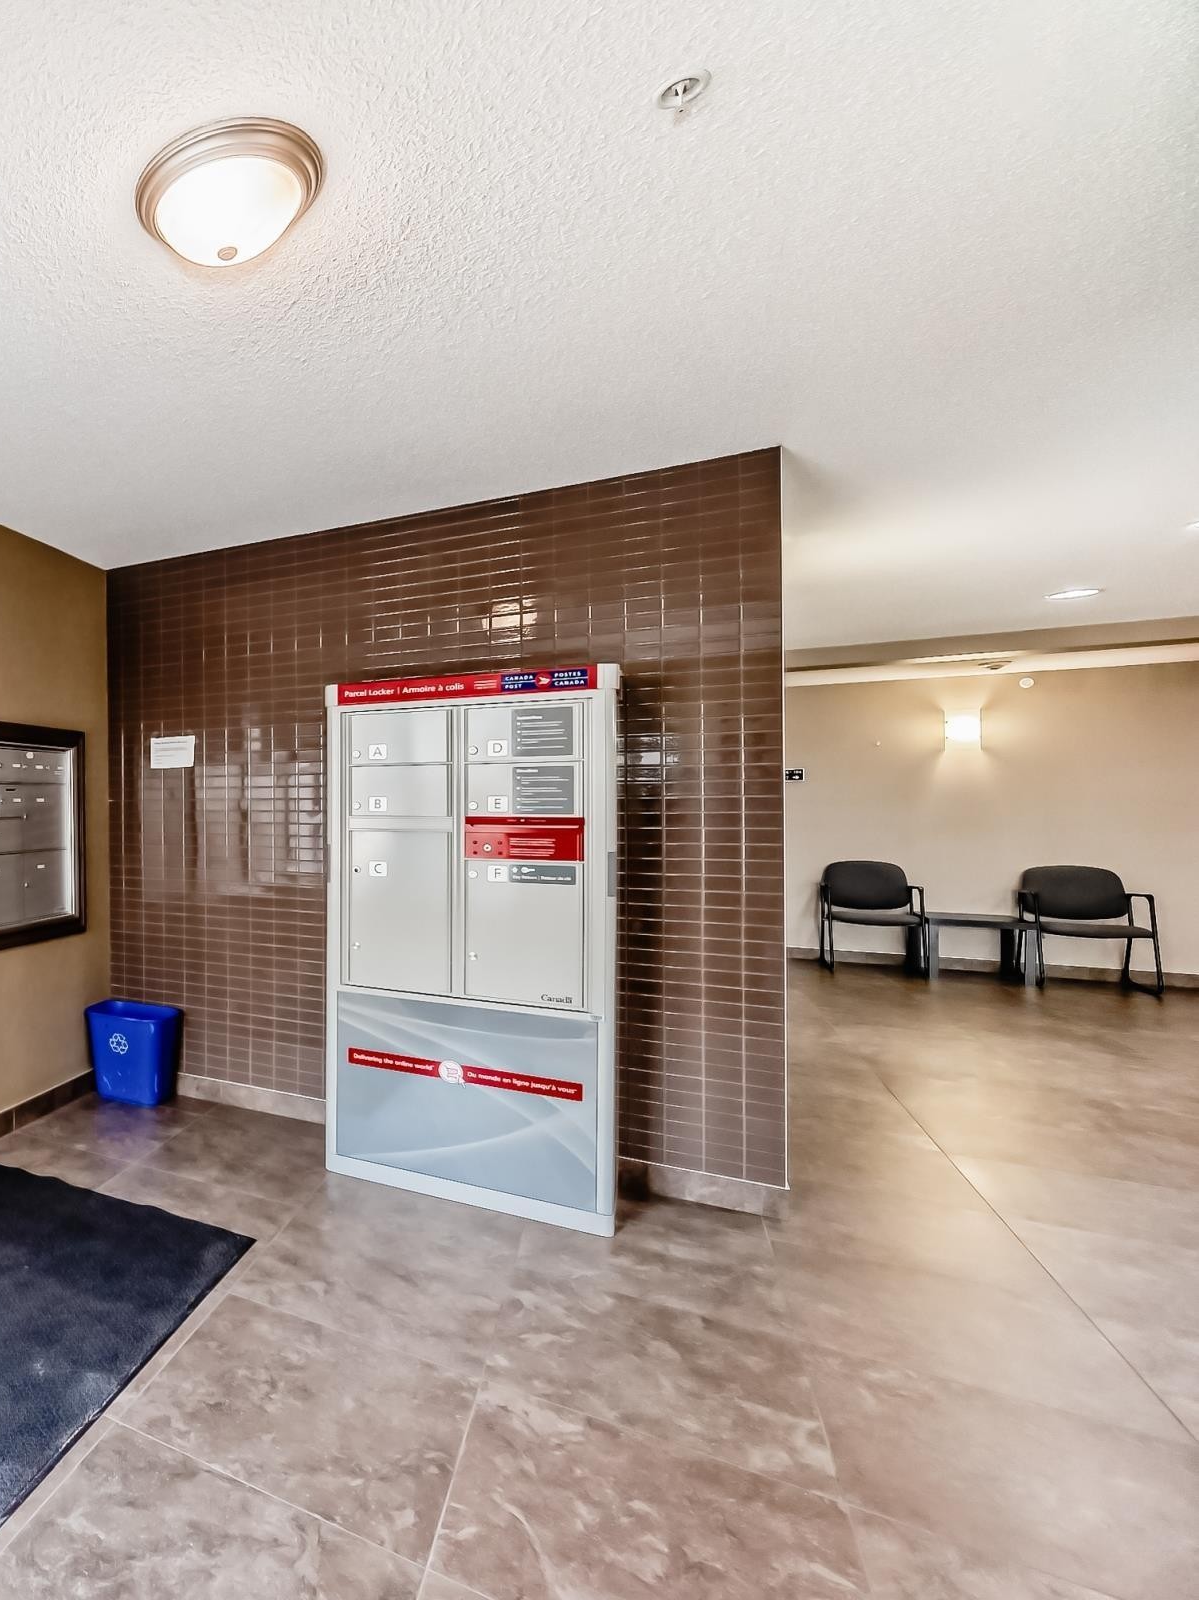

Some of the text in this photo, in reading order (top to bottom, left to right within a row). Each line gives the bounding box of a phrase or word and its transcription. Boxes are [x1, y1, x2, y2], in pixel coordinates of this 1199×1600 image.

[344, 682, 464, 698] Parcel Locker Armoire à colis
[372, 746, 383, 757] A
[492, 742, 503, 754] D
[374, 798, 382, 809] B
[494, 798, 501, 809] E
[374, 863, 382, 874] C
[494, 867, 501, 879] F
[541, 994, 573, 1004] Canada
[353, 1052, 383, 1064] Delivering
[394, 1060, 413, 1068] online
[478, 1073, 501, 1082] monde
[512, 1077, 530, 1087] ligne
